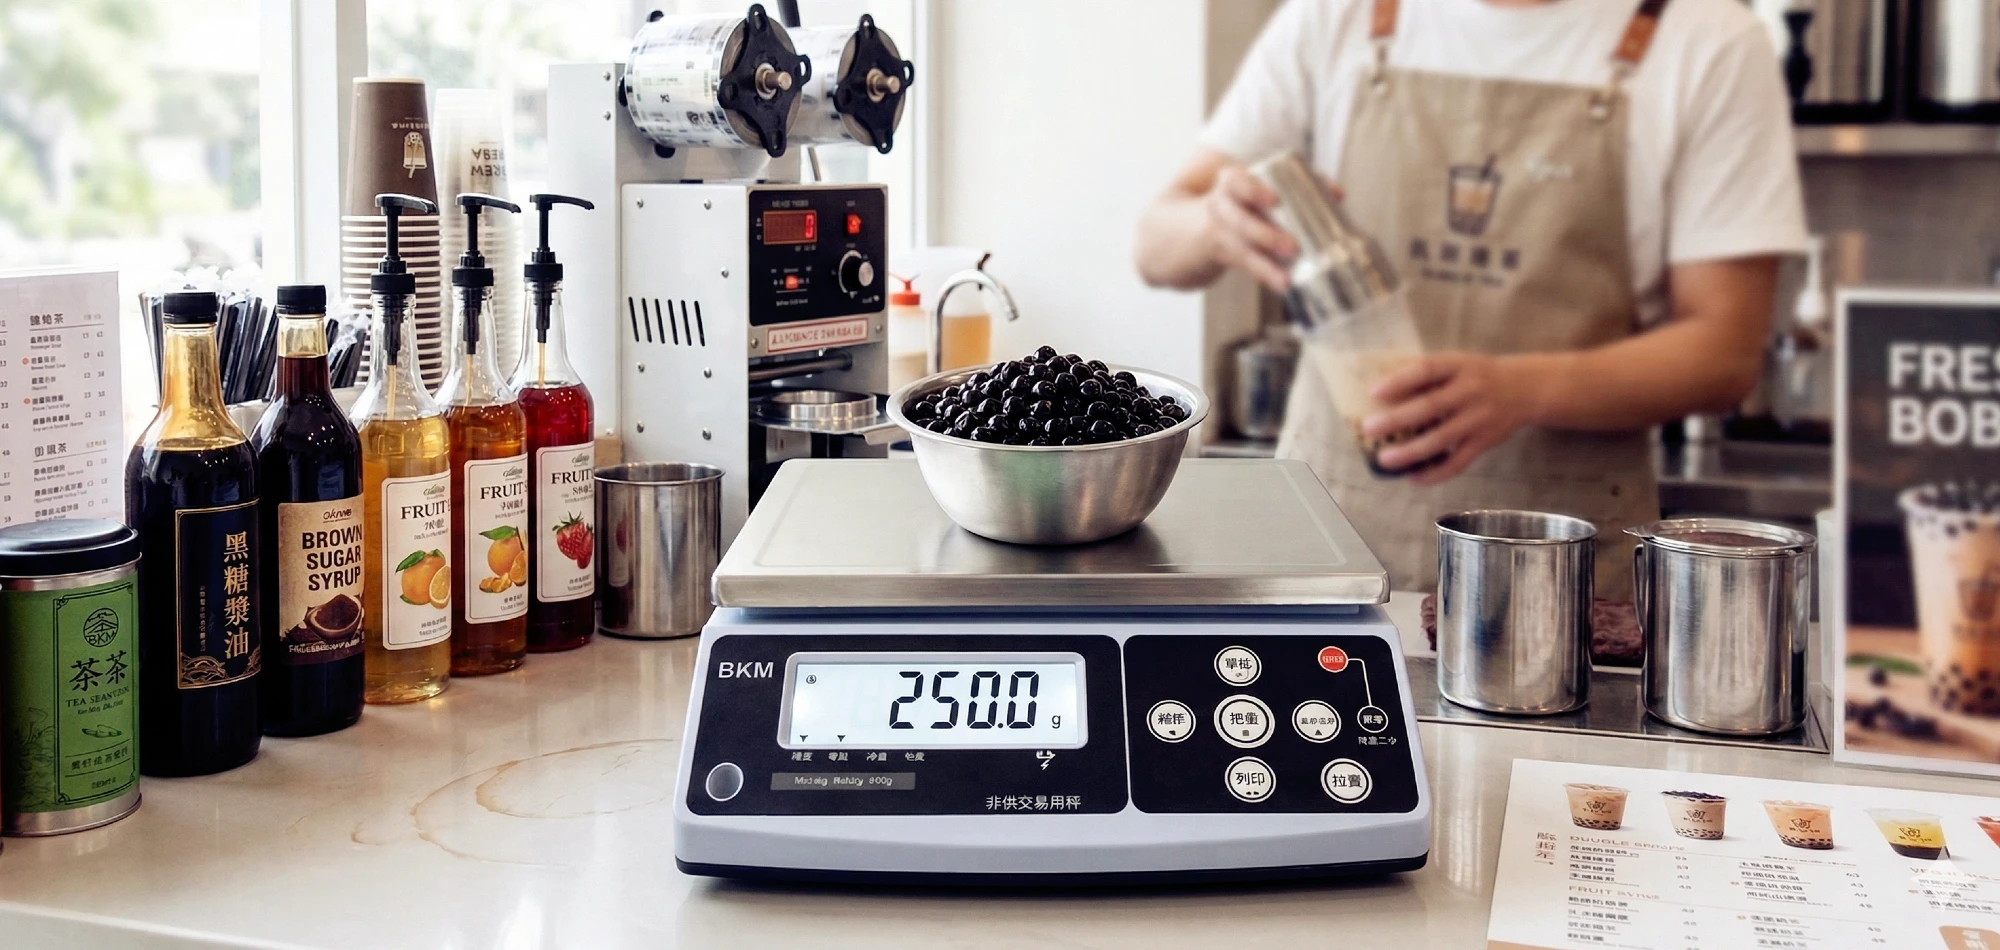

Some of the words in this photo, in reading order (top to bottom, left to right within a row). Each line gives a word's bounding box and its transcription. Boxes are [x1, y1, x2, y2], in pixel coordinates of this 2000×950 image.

[1889, 342, 2000, 393] FRE
[302, 523, 363, 550] BROWN
[306, 545, 362, 571] SUGAR
[308, 565, 361, 592] SYRUP
[223, 530, 250, 660] 黑糖漿油
[87, 630, 116, 646] BKM
[69, 649, 129, 692] 茶茶
[718, 661, 774, 679] BKM
[65, 697, 87, 708] TEA
[889, 671, 1040, 729] 250.0
[1051, 714, 1061, 729] g
[1235, 772, 1265, 786] 列印
[985, 794, 1082, 811] 非供交易用秤
